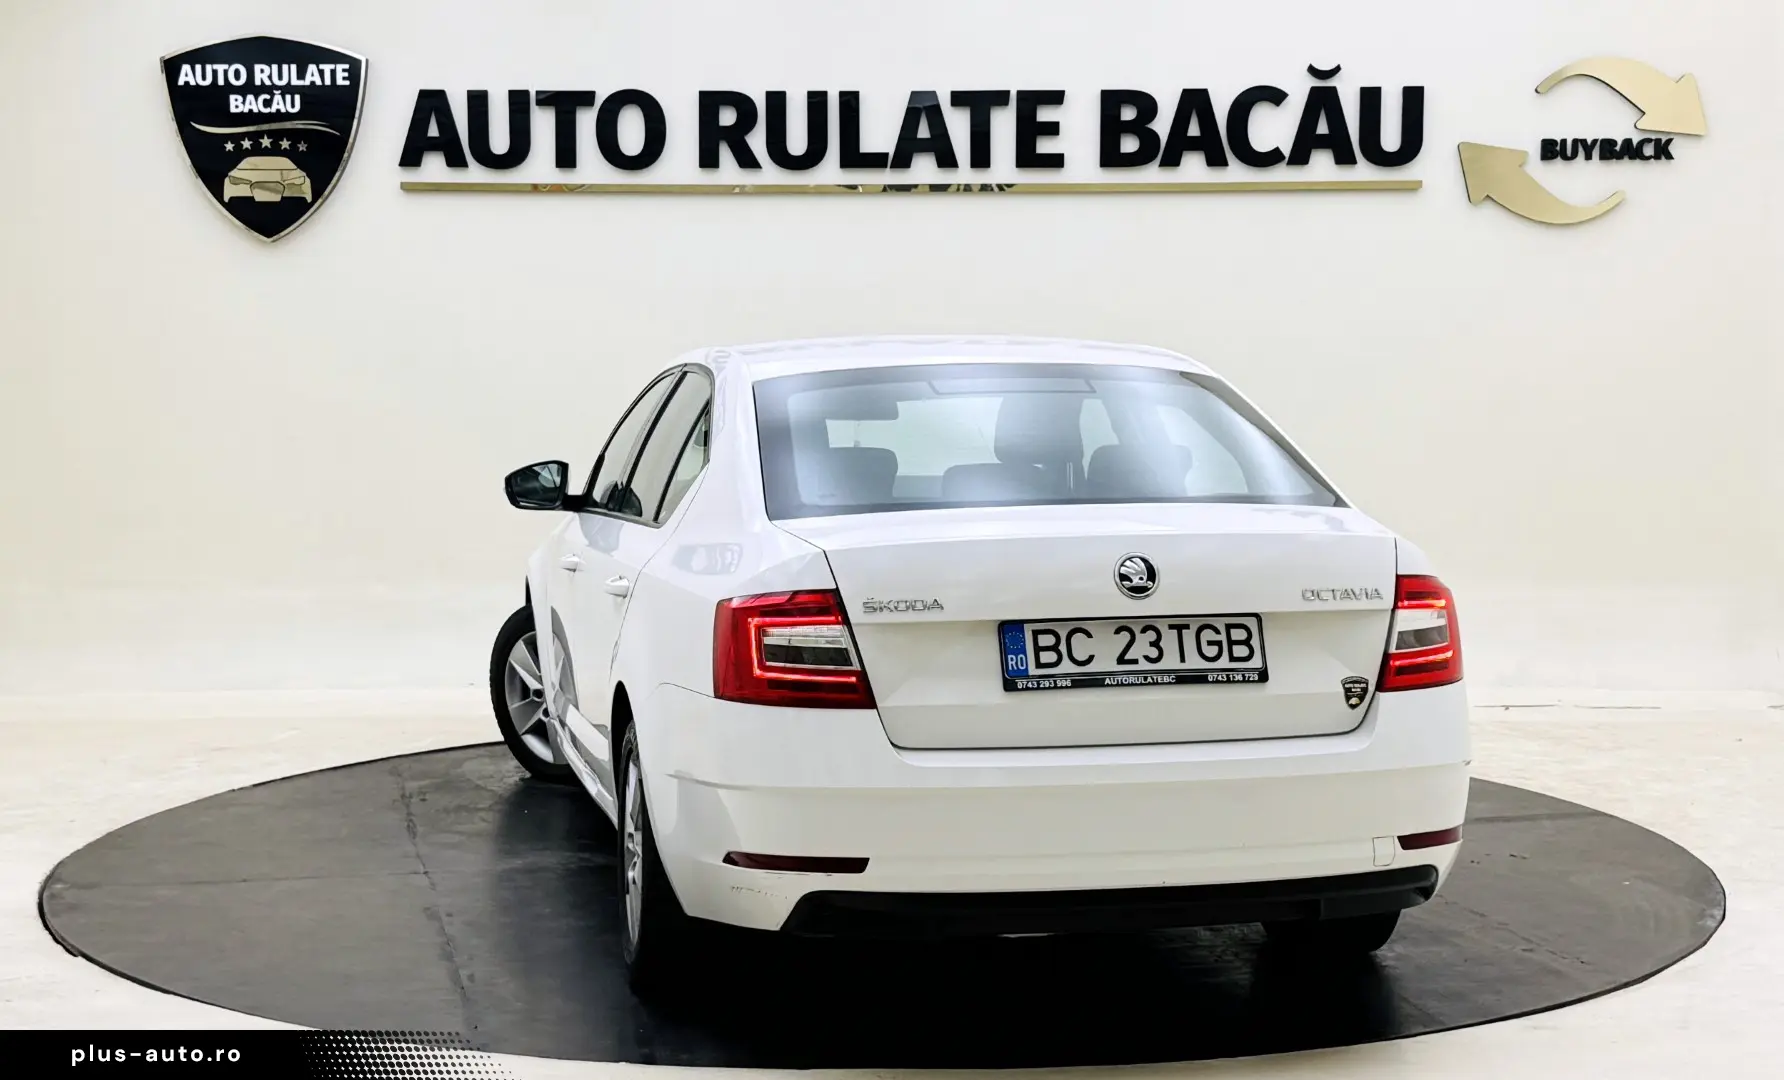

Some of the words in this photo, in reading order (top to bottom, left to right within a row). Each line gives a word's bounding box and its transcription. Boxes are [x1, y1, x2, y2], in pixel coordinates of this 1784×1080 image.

[177, 63, 248, 87] AUTO
[253, 63, 351, 87] RULATE
[228, 89, 301, 114] BACĂU
[398, 87, 668, 171] AUTO
[697, 89, 1066, 170] RULATE
[1099, 62, 1426, 169] BACĂU
[1539, 136, 1676, 162] BUYBACK
[1301, 586, 1385, 602] OCTAVIA
[862, 596, 945, 614] ŠKODA
[1030, 626, 1096, 670] BC
[1112, 622, 1256, 666] 23TGB
[1007, 654, 1027, 672] RO
[1016, 680, 1038, 689] 0743
[1039, 680, 1055, 689] 293
[1056, 679, 1072, 688] 996
[1103, 675, 1177, 686] AUTORULATEBC
[1207, 674, 1228, 682] 0743
[1229, 673, 1243, 682] 136
[1244, 673, 1259, 682] 729
